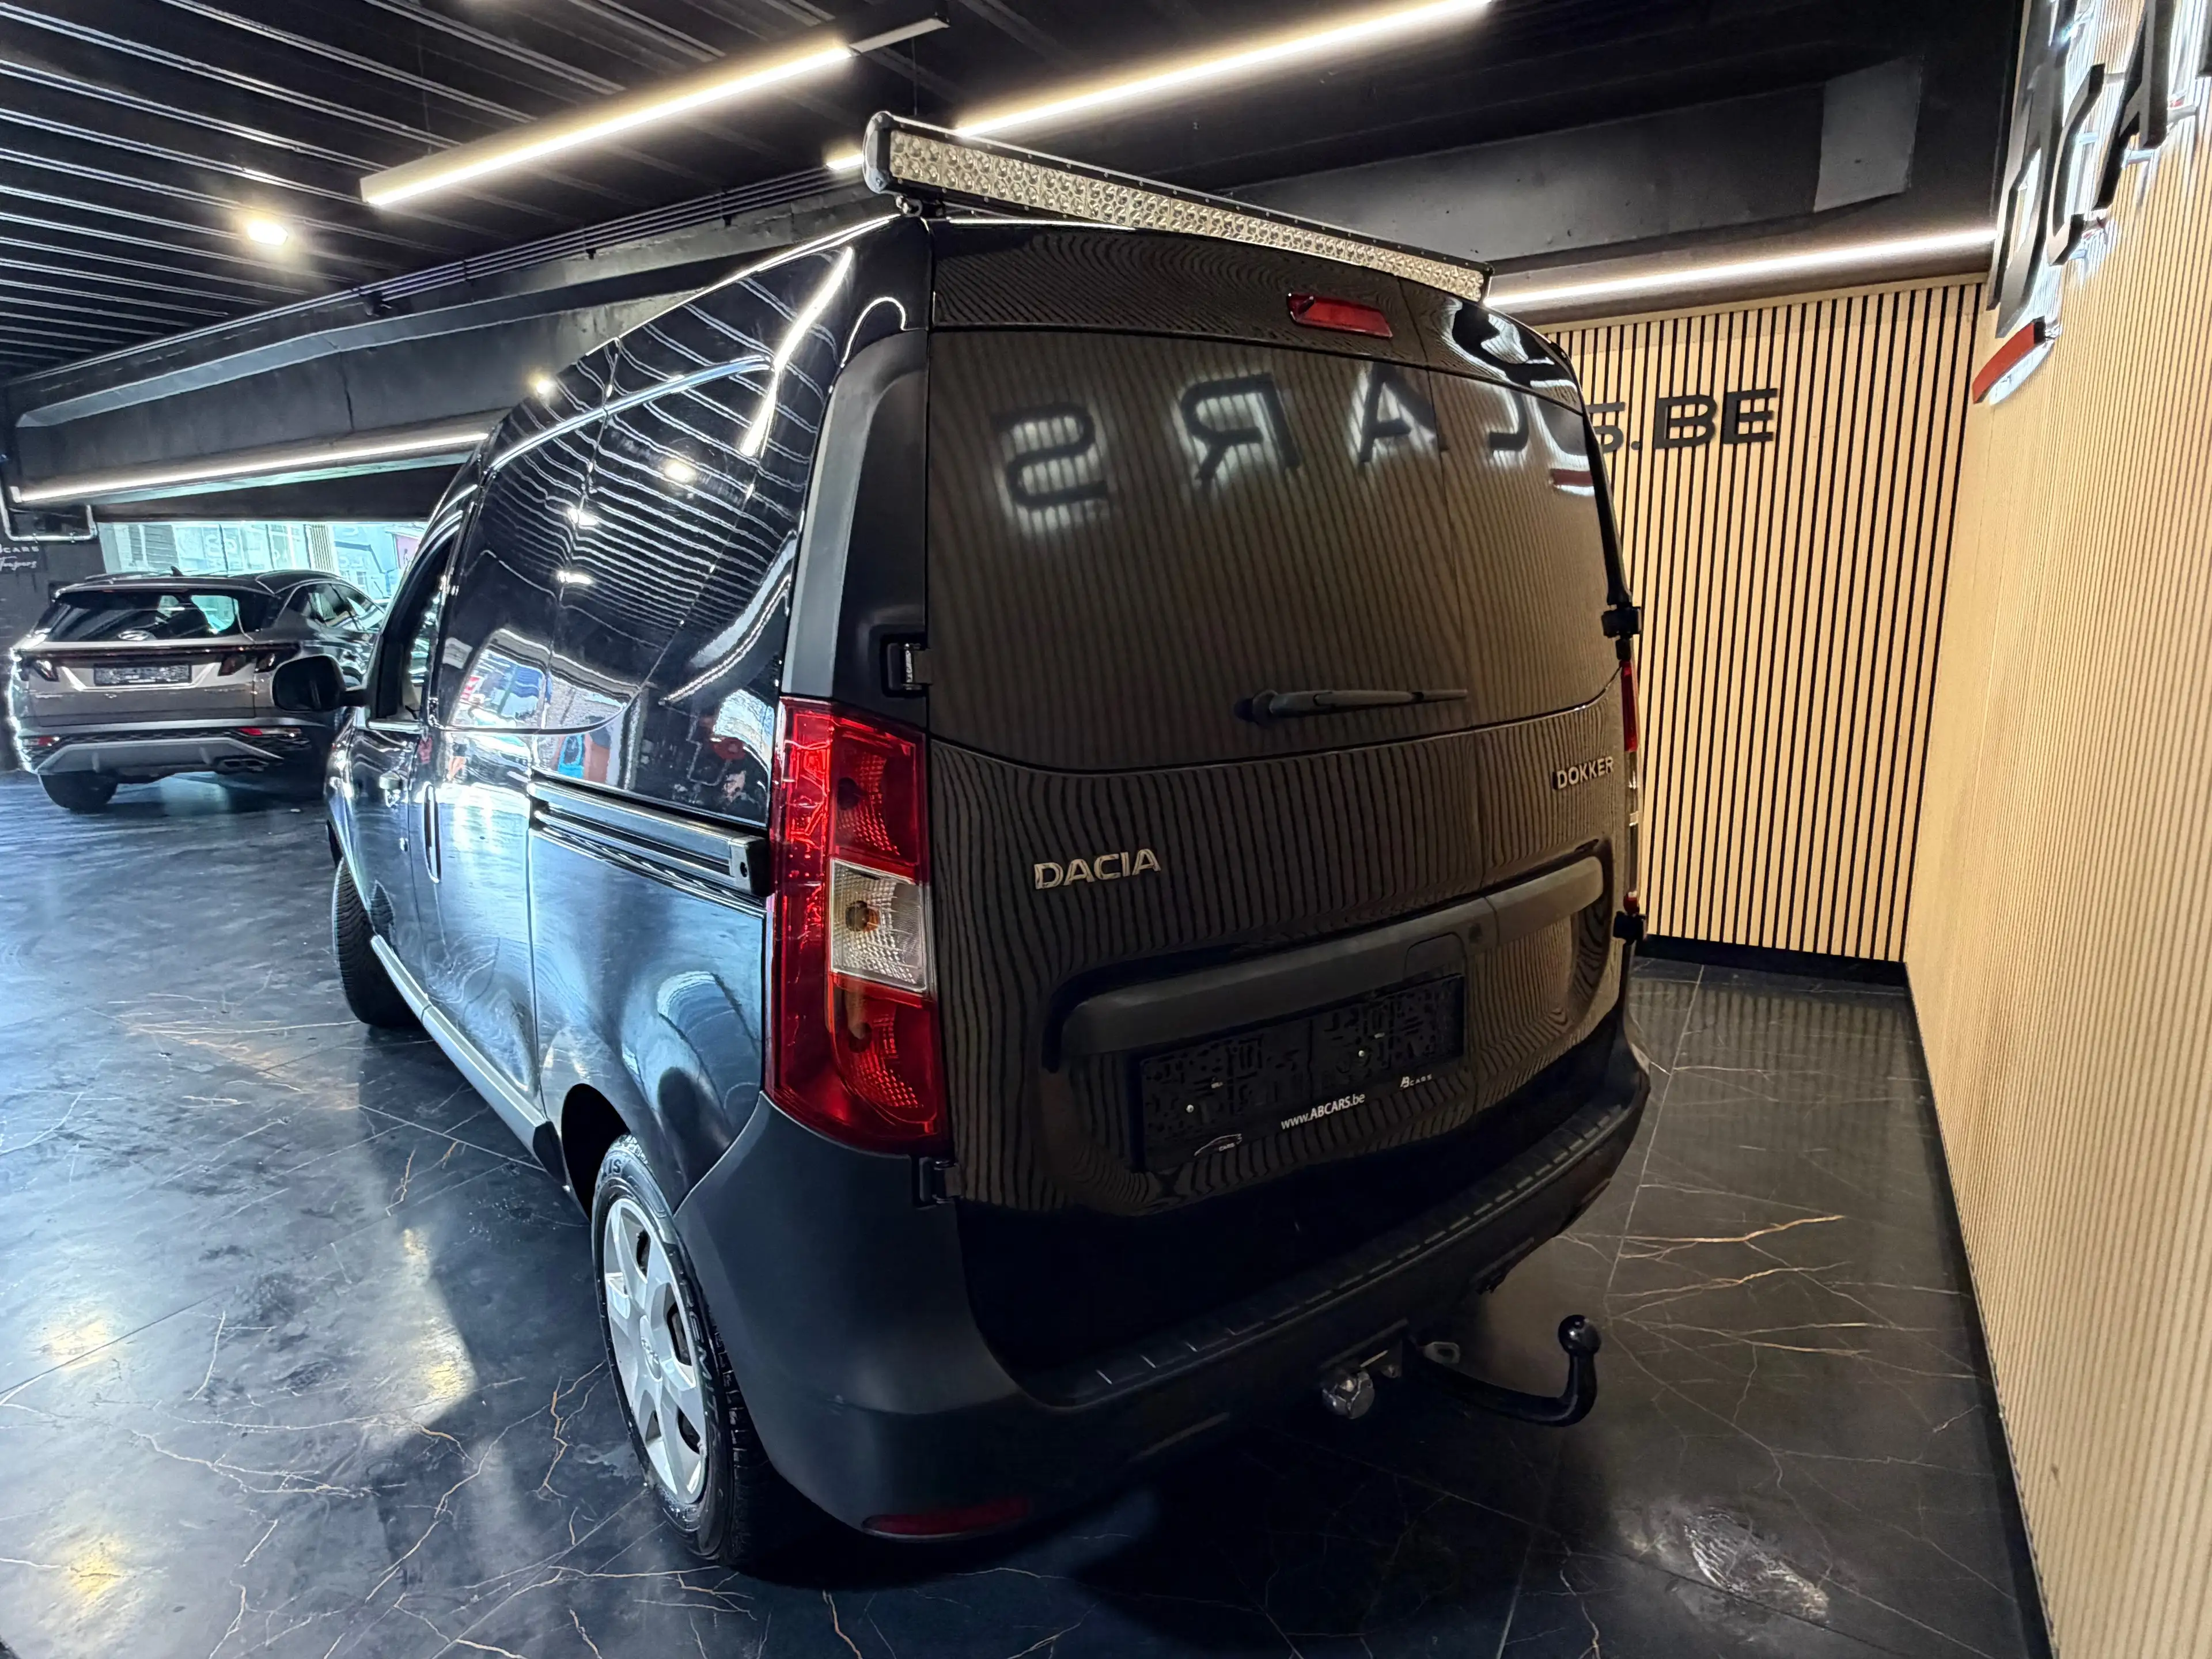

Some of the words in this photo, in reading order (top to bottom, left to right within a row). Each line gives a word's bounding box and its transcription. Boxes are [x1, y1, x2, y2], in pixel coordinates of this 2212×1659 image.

[1555, 755, 1613, 790] DOKKER
[1034, 848, 1161, 889] DACIA
[1281, 1093, 1366, 1130] www.ABCARS.be
